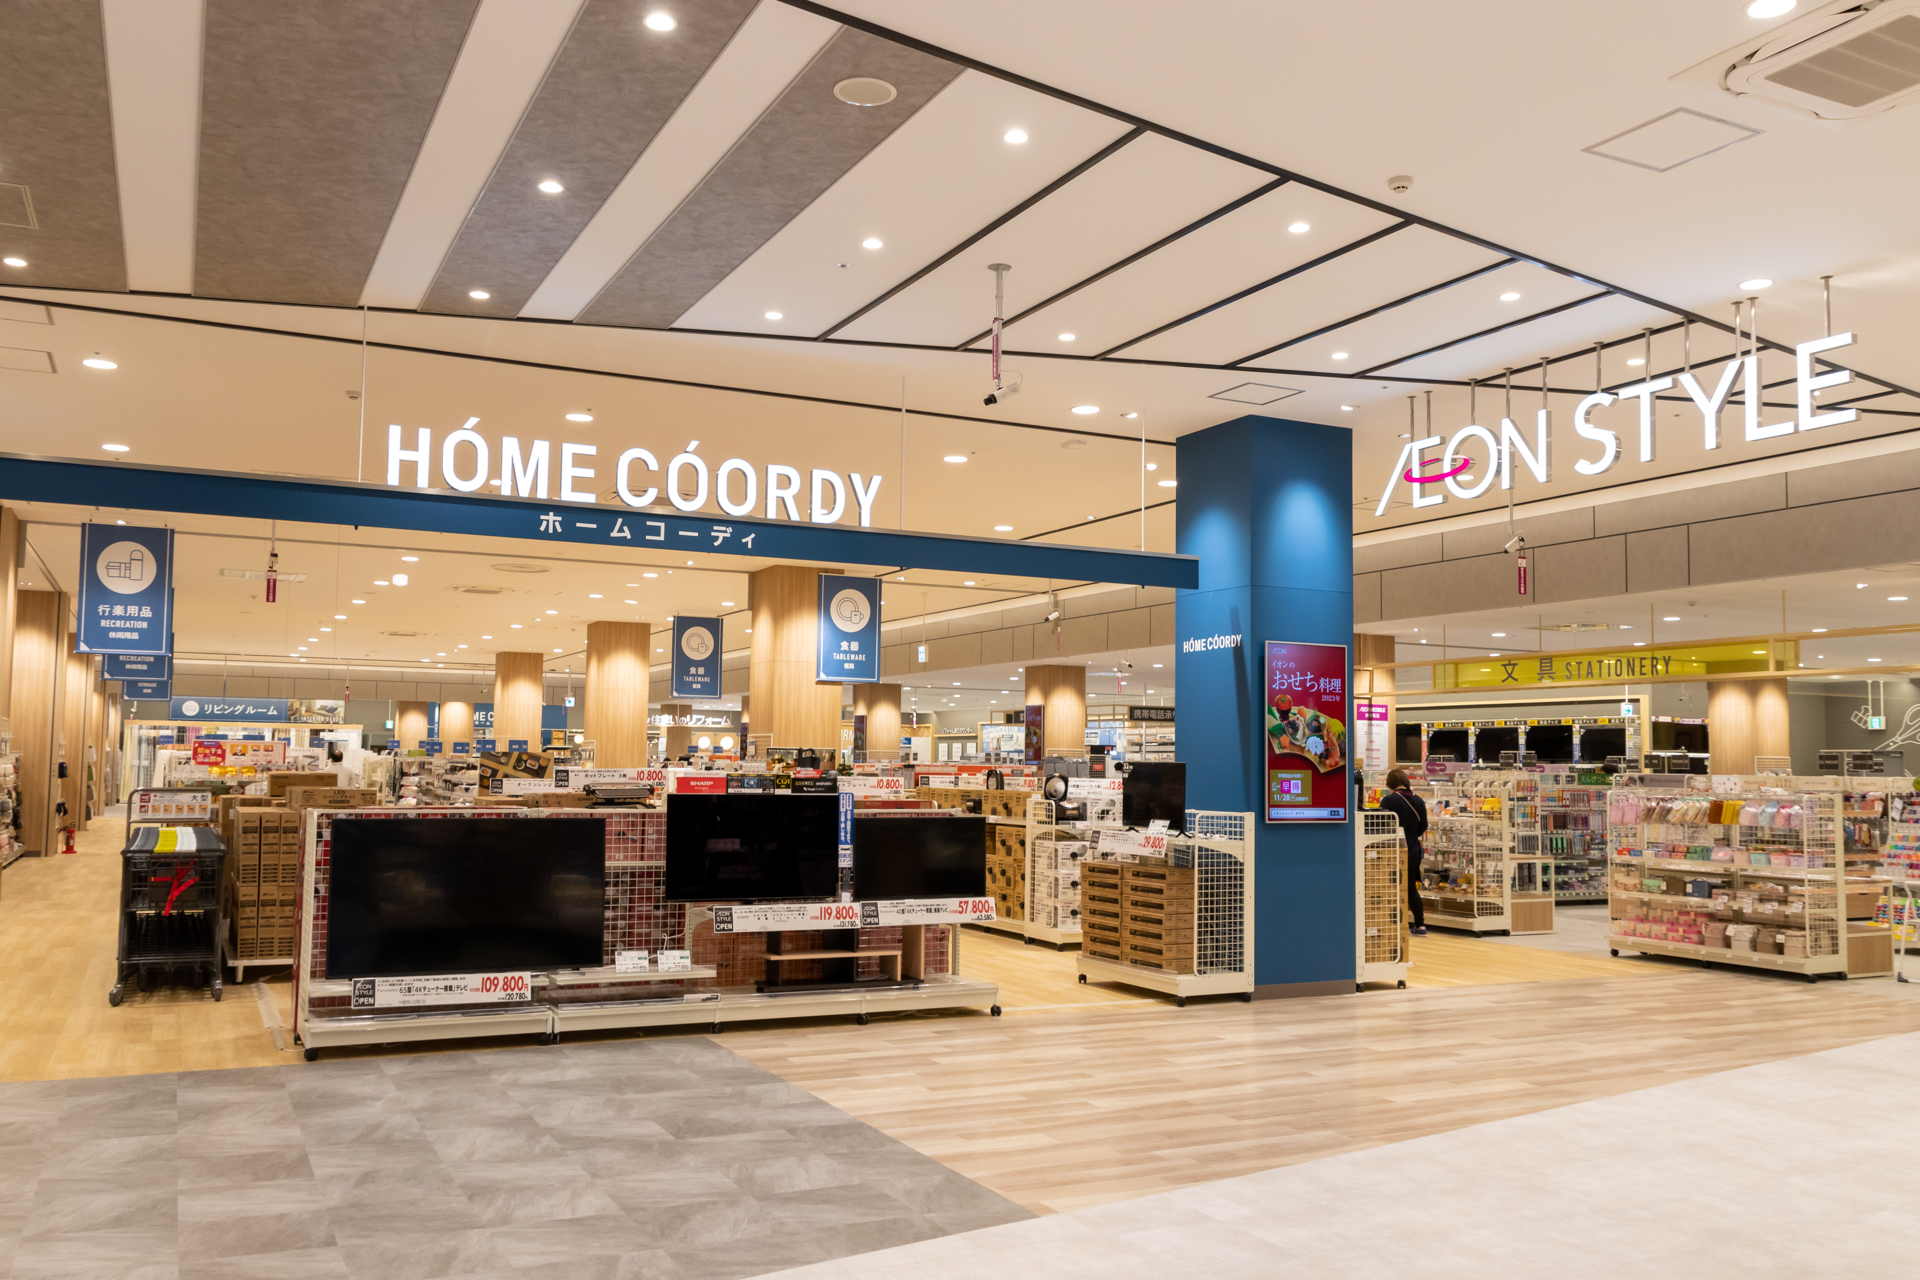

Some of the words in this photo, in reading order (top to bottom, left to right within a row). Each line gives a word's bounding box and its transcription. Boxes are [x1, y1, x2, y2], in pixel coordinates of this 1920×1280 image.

[1574, 332, 1861, 476] STYLE
[386, 417, 597, 504] HÓME
[539, 511, 757, 548] ホームコーディ
[97, 604, 153, 618] 行楽用品
[101, 620, 148, 629] RECREATION
[840, 640, 859, 652] 食器
[1183, 637, 1206, 653] HÓME
[833, 652, 866, 661] TABLEWARE
[689, 666, 705, 675] 食器
[1272, 660, 1296, 669] イオンの
[1565, 655, 1672, 680] STATIONERY
[1271, 670, 1342, 693] おせち料理
[204, 704, 278, 716] リビングルーム
[191, 794, 209, 802] 大型
[820, 906, 858, 921] 119,800円
[958, 900, 994, 915] 57,800円
[715, 923, 733, 931] OPEN
[862, 917, 879, 925] OPEN
[480, 975, 529, 993] 109,800円
[353, 997, 375, 1005] OPEN
